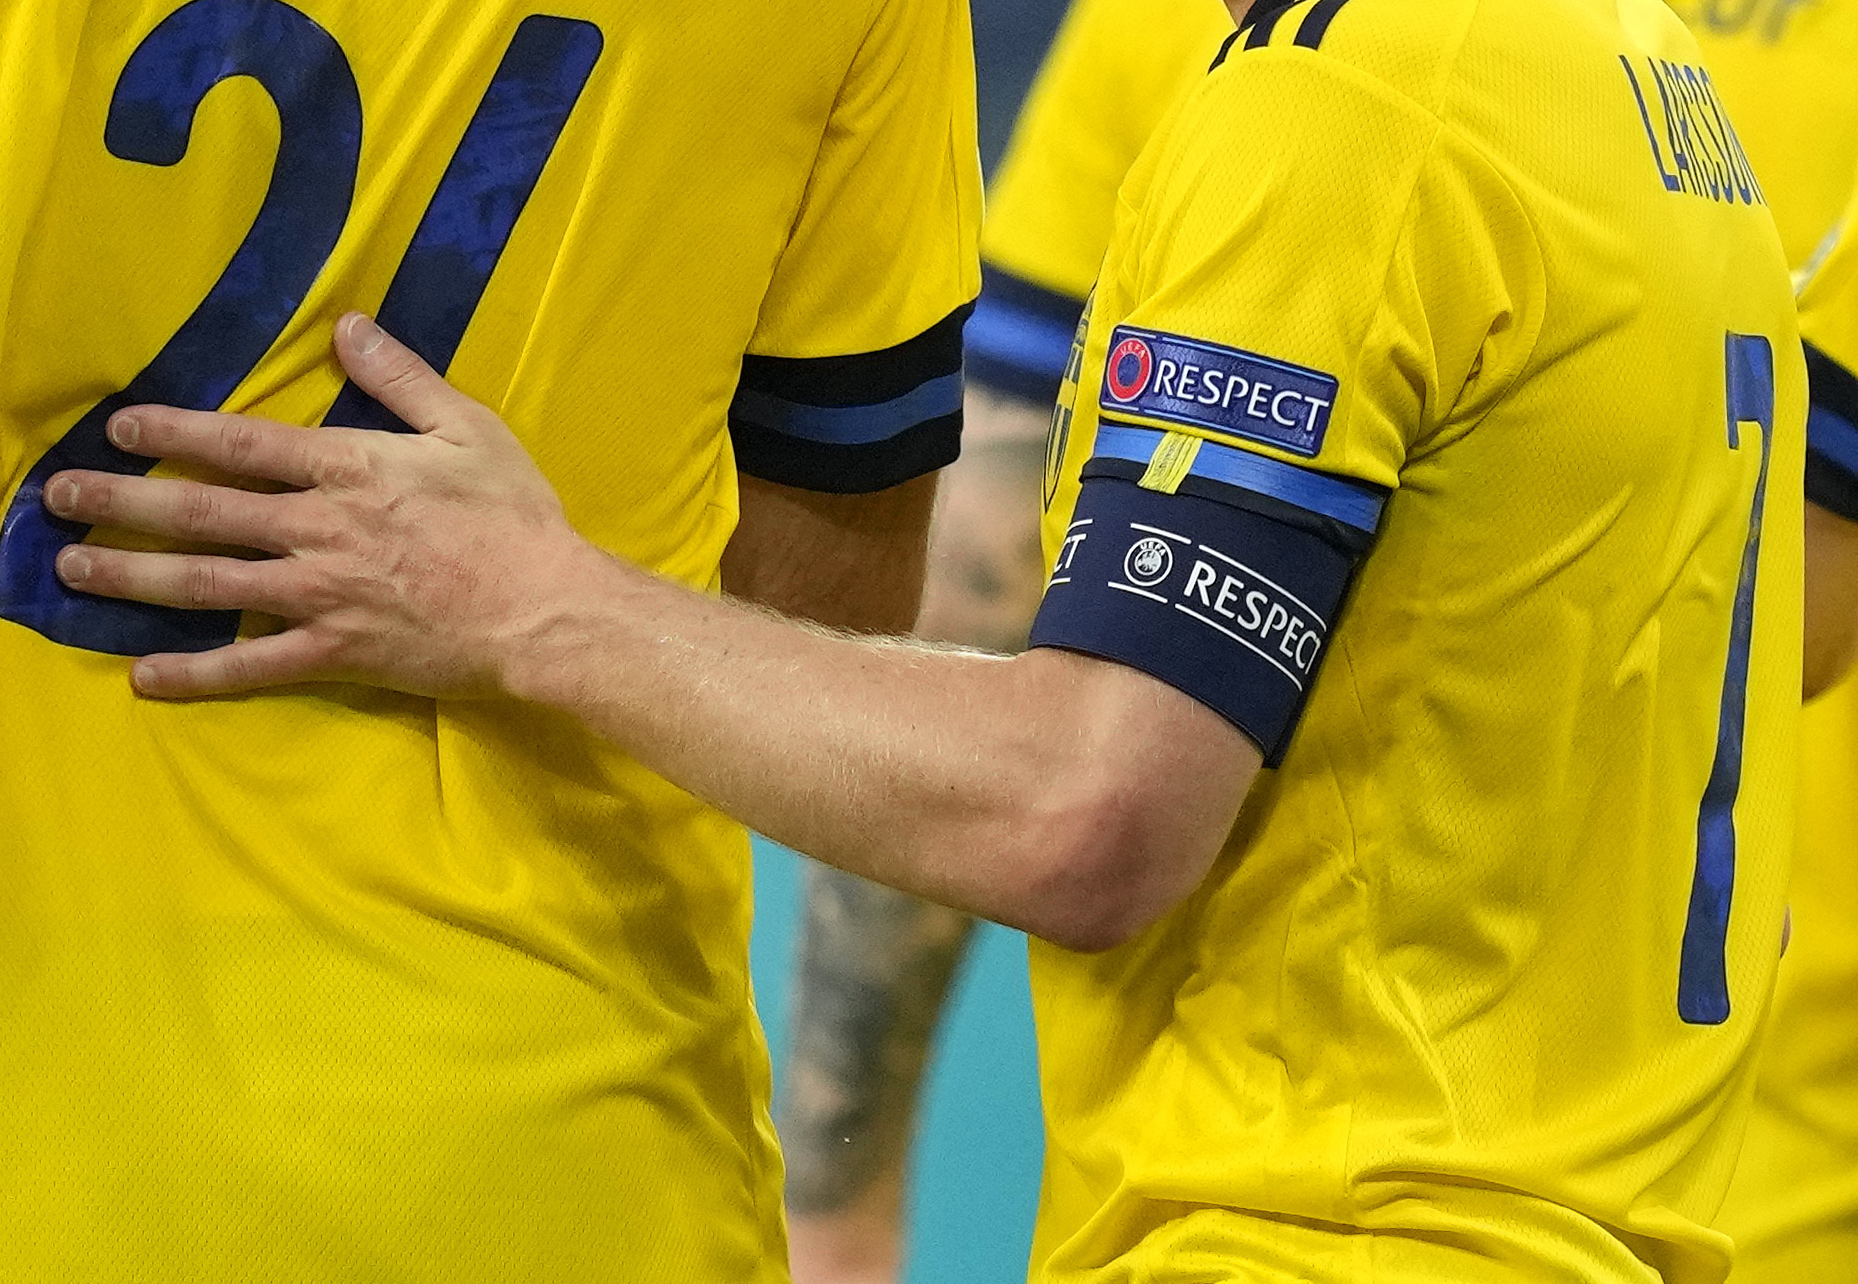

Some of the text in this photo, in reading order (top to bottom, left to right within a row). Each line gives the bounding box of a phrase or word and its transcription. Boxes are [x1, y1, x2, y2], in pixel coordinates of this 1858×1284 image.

[1618, 54, 1767, 206] LARSSO
[1119, 341, 1330, 432] UEFA RESPECT
[1139, 540, 1167, 557] UEFA
[1677, 329, 1775, 1025] 7
